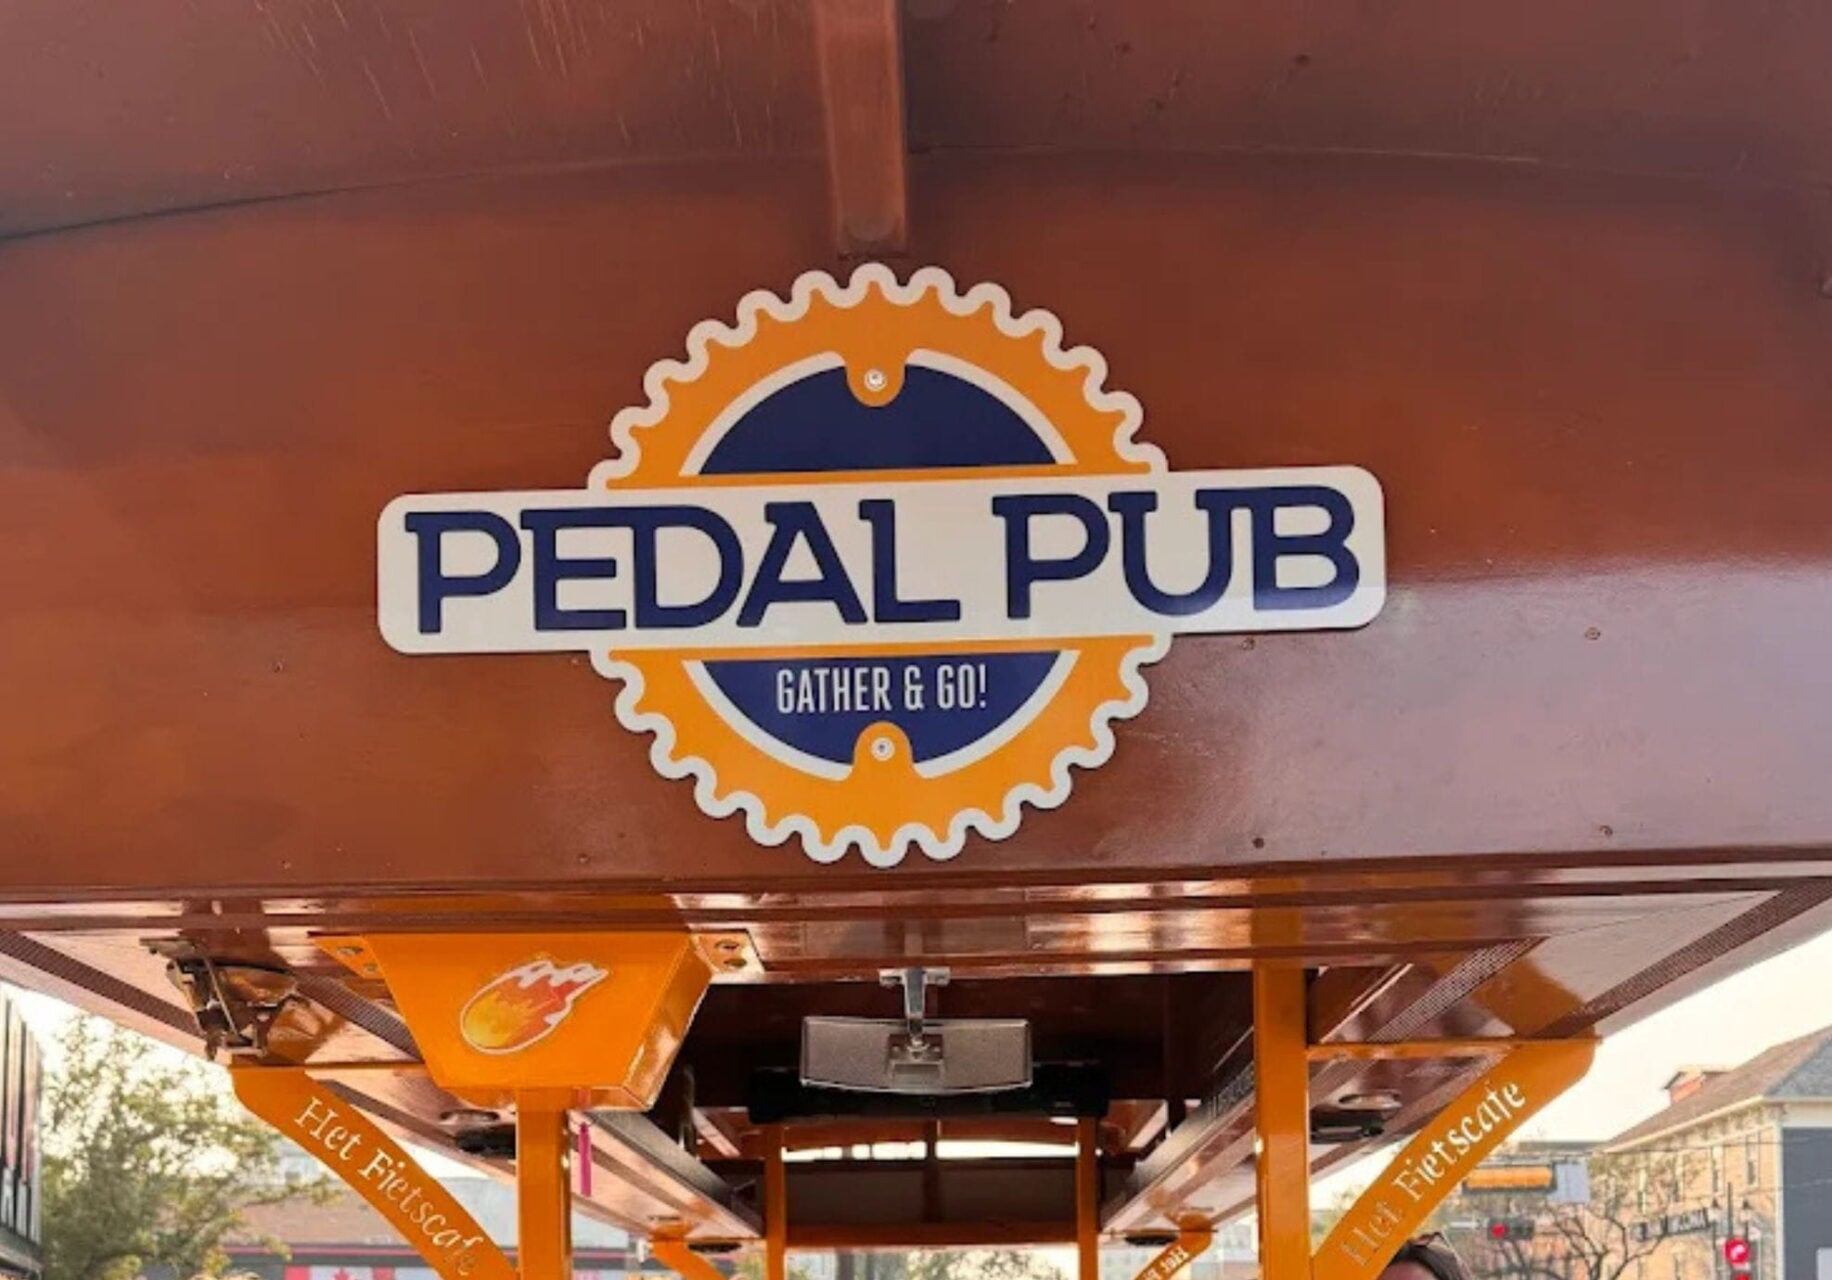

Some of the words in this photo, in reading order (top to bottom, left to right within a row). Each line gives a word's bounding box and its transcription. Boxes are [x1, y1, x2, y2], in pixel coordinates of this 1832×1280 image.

[405, 499, 961, 634] PEDAL
[992, 485, 1361, 619] PUB
[776, 667, 893, 714] GATHER
[904, 665, 924, 710] &
[936, 664, 987, 709] GO!
[294, 1096, 361, 1160] Het
